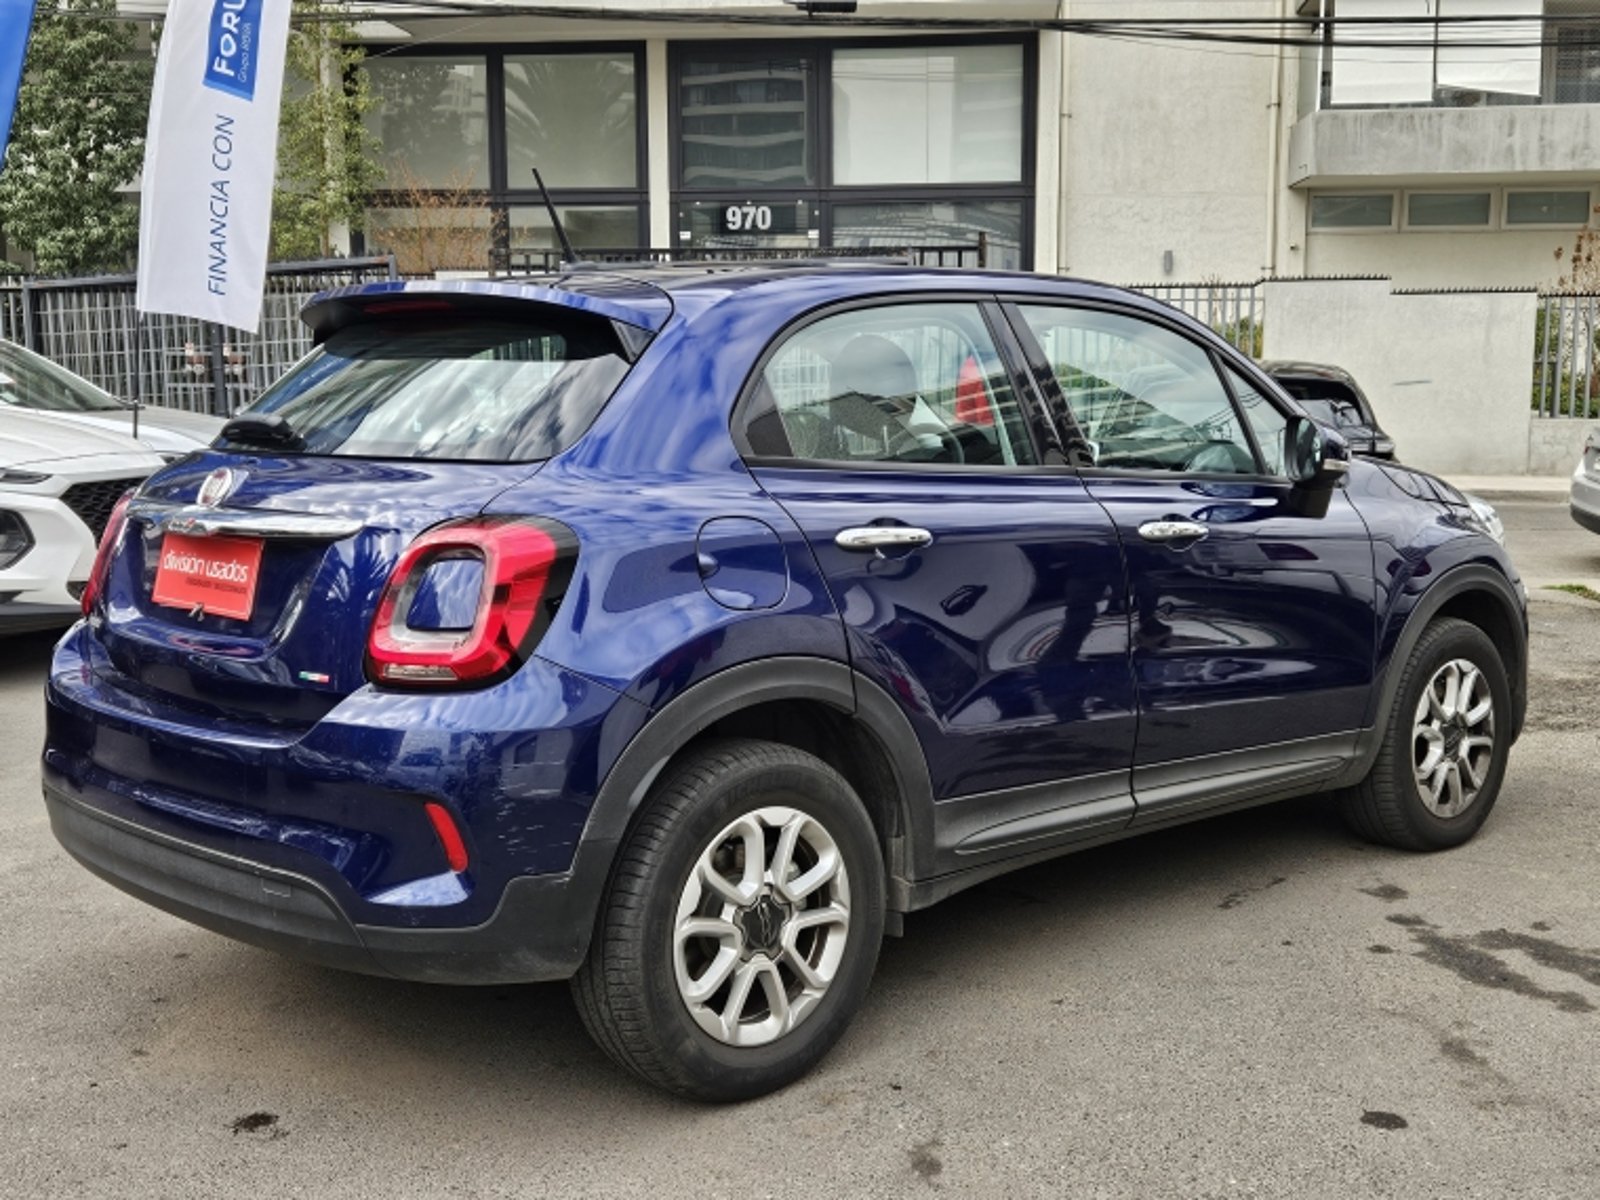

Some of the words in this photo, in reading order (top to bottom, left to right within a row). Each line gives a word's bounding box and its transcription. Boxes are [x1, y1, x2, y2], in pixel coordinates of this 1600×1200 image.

[212, 113, 235, 172] CON
[207, 180, 231, 296] FINANCIA
[726, 206, 771, 230] 970
[205, 559, 249, 583] usados
